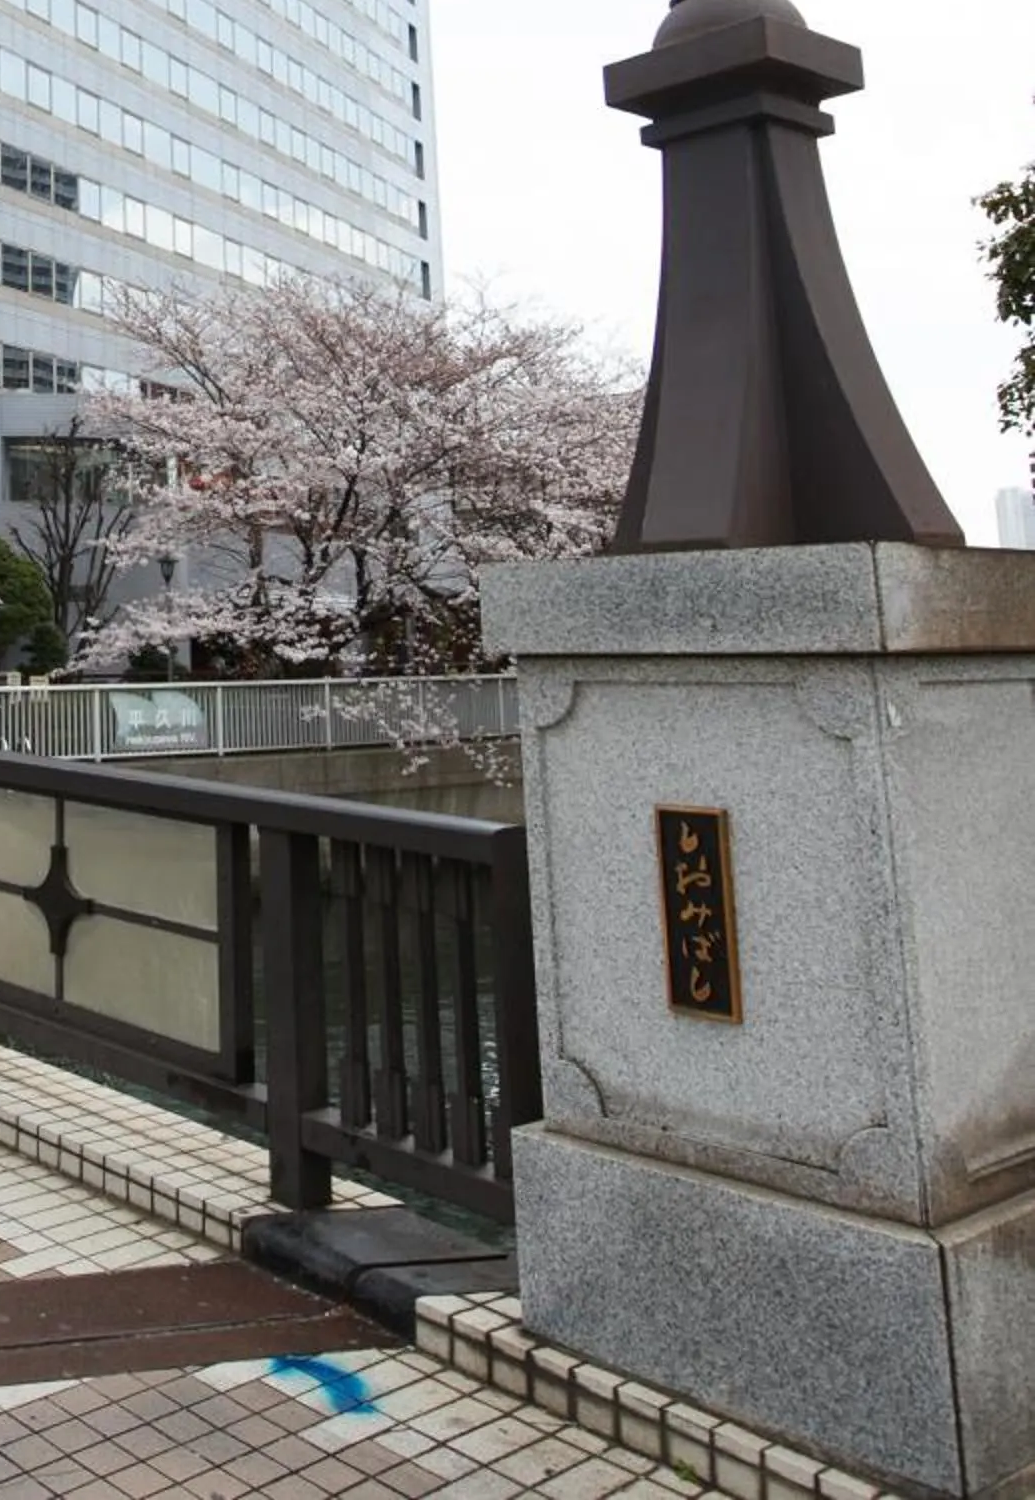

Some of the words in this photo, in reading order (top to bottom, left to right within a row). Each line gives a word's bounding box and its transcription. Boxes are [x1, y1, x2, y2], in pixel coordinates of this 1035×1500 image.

[674, 820, 721, 1001] しおみばし
